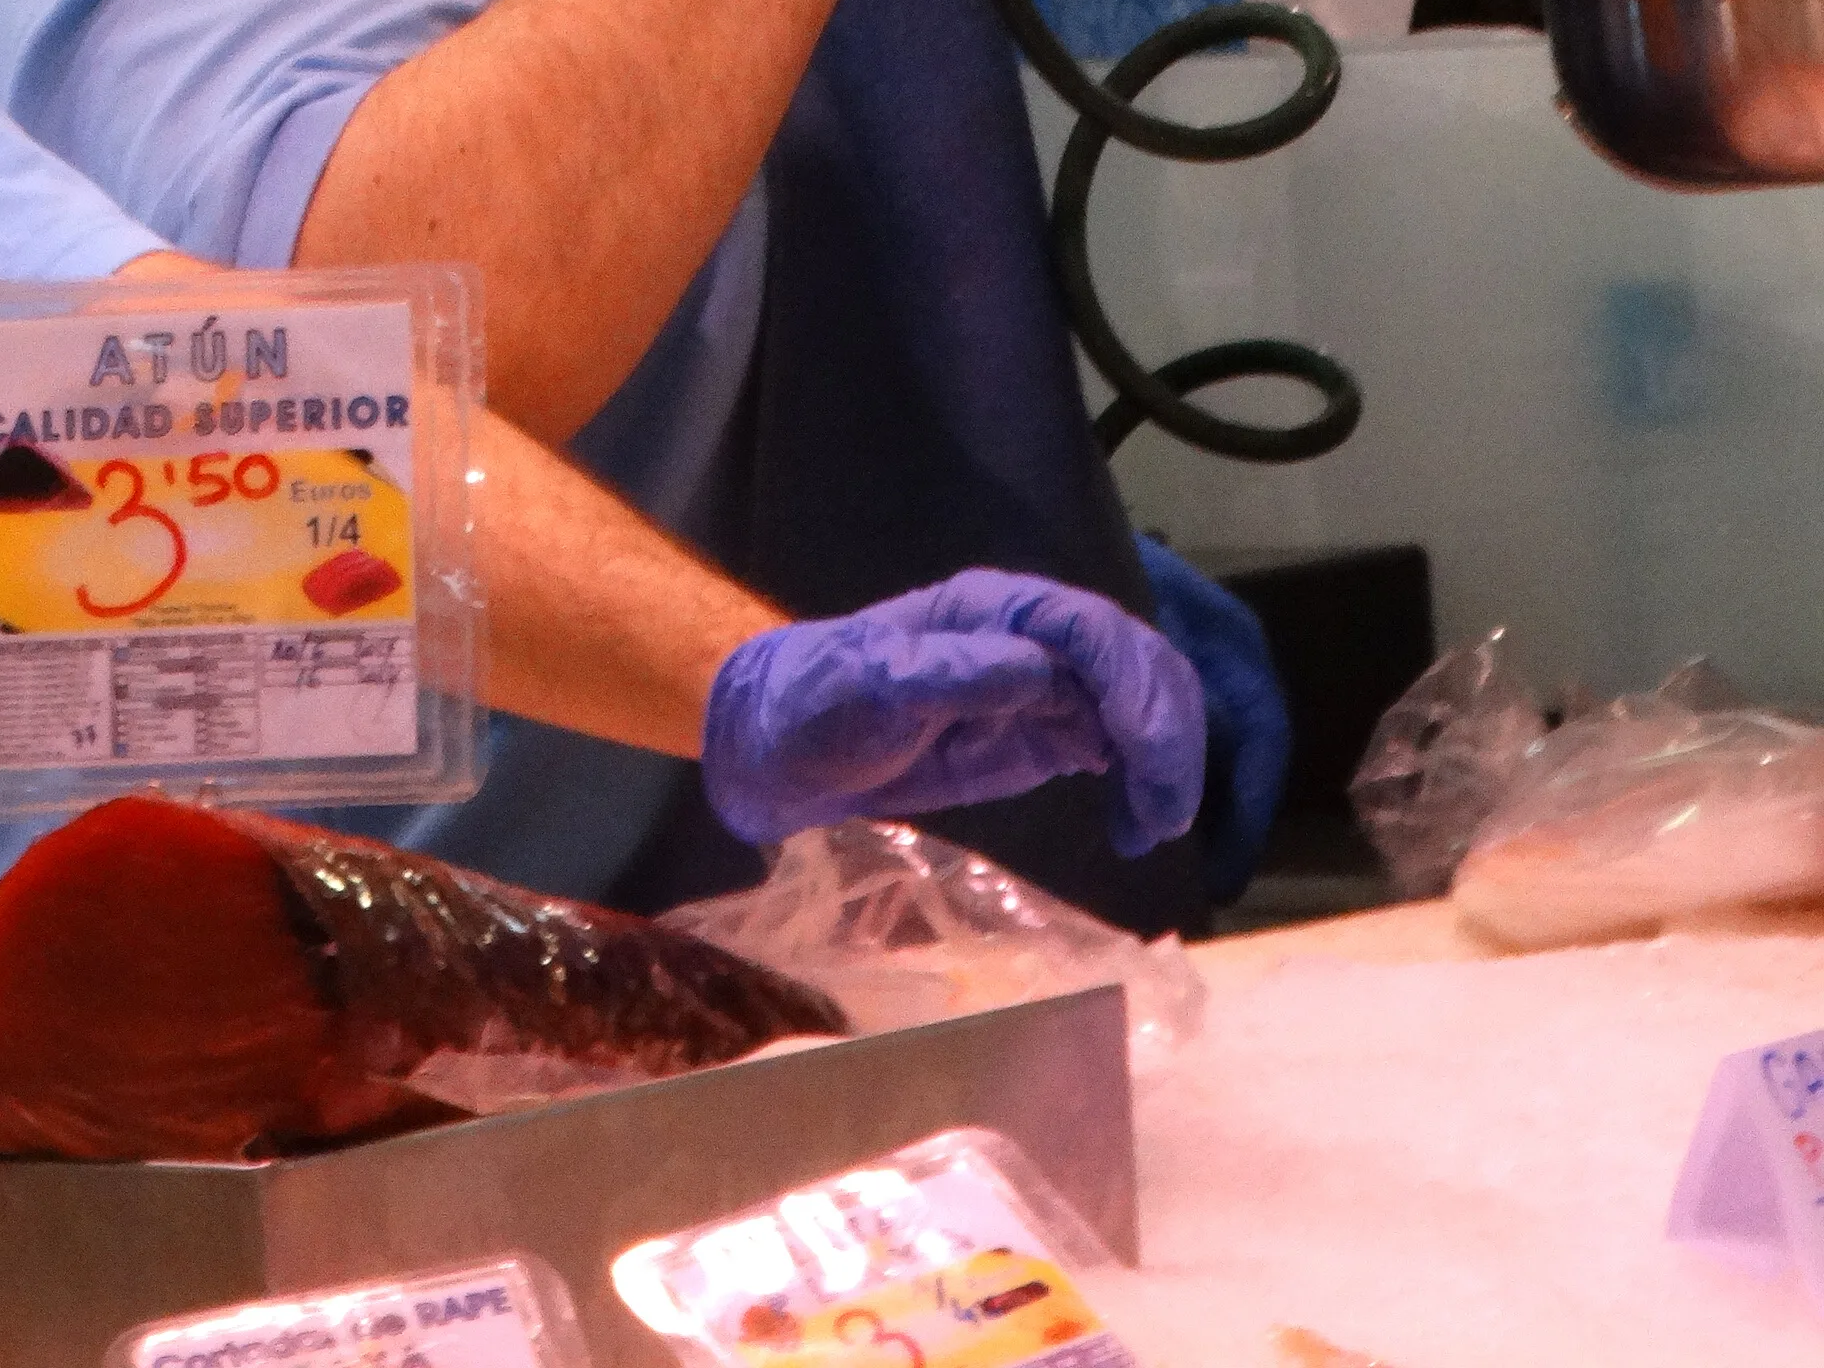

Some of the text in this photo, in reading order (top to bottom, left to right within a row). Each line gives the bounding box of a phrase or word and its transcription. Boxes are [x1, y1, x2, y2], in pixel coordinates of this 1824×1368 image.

[88, 316, 289, 388] ATÚN
[193, 393, 411, 437] SUPERIOR
[289, 478, 373, 504] Euros
[305, 514, 362, 550] 1/4
[414, 1285, 514, 1327] RAPE
